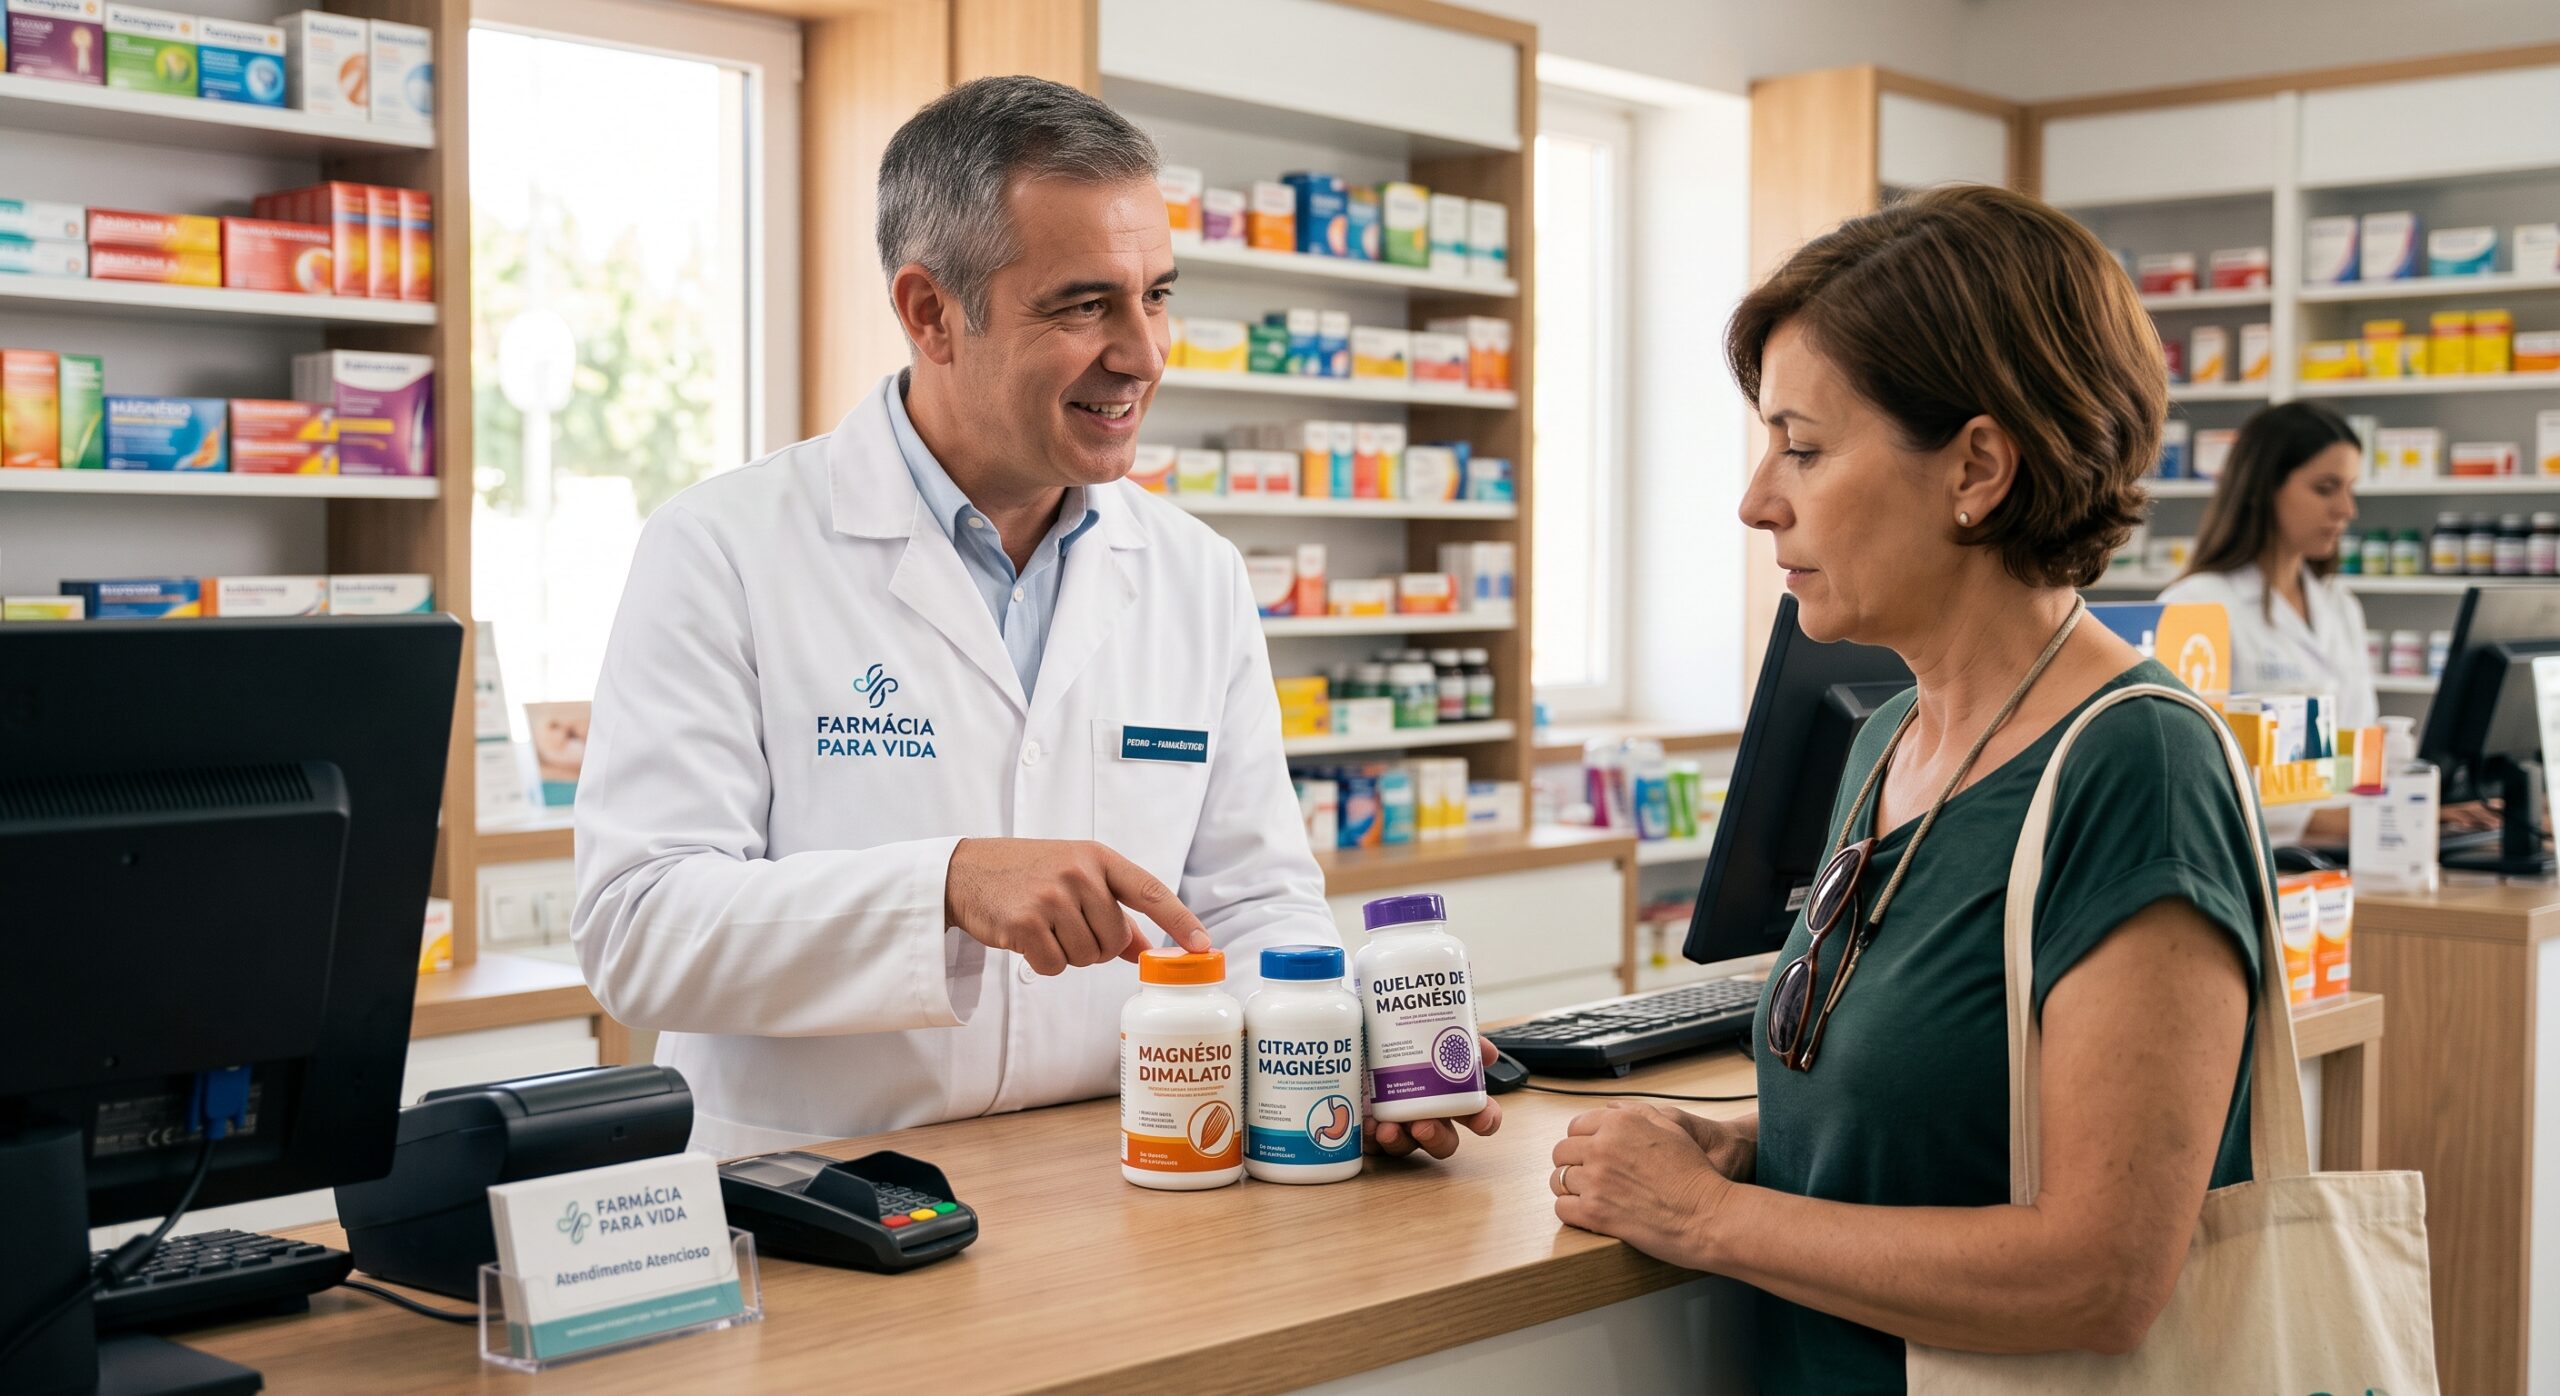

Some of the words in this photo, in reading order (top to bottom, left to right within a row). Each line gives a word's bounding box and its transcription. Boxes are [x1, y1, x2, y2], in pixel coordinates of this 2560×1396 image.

[817, 713, 935, 736] FARMÁCIA
[817, 739, 877, 756] PARA
[882, 739, 937, 758] VIDA
[1373, 972, 1446, 996] QUELATO
[1449, 971, 1466, 985] DE
[1376, 987, 1467, 1014] MAGNÉSIO
[1139, 1042, 1231, 1063] MAGNÉSIO
[1258, 1039, 1329, 1055] CITRATO
[1334, 1038, 1352, 1054] DE
[1139, 1065, 1231, 1083] DIMALATO
[1259, 1055, 1352, 1076] MAGNÉSIO
[596, 1187, 682, 1214] FARMÁCIA
[600, 1215, 644, 1235] PARA
[648, 1206, 687, 1226] VIDA
[556, 1260, 642, 1287] Atendimento
[645, 1245, 711, 1267] Atencioso
